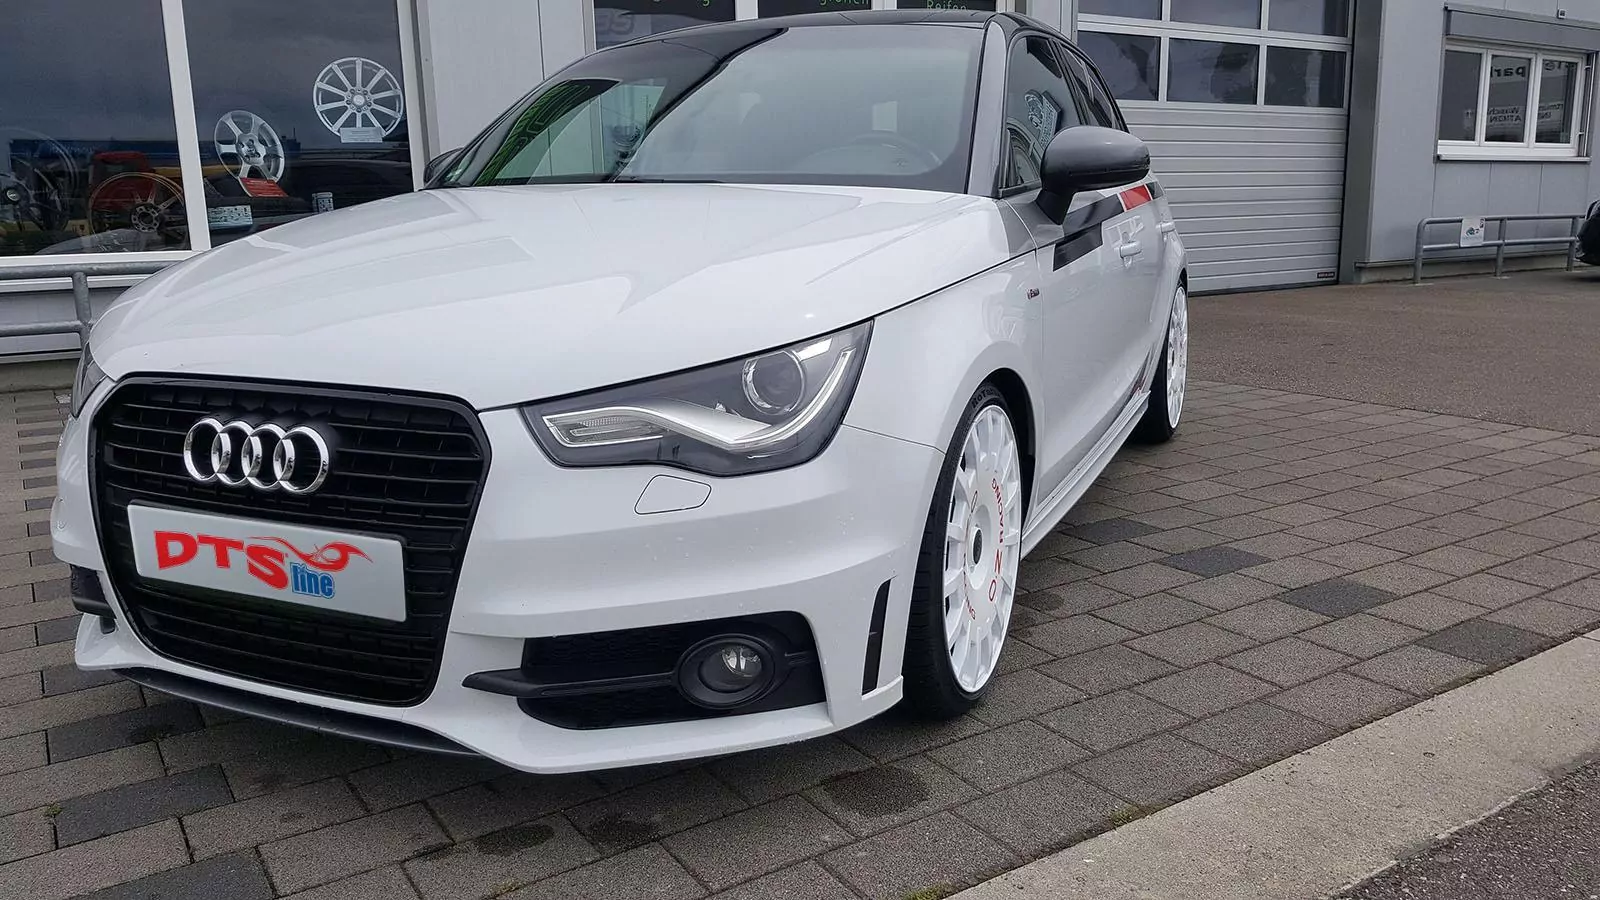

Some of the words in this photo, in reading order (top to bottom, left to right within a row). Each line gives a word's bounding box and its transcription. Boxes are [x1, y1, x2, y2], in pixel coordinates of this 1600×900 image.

[926, 0, 968, 11] Reifen
[991, 478, 1004, 544] RACING
[153, 531, 290, 590] DTS
[291, 562, 335, 599] line
